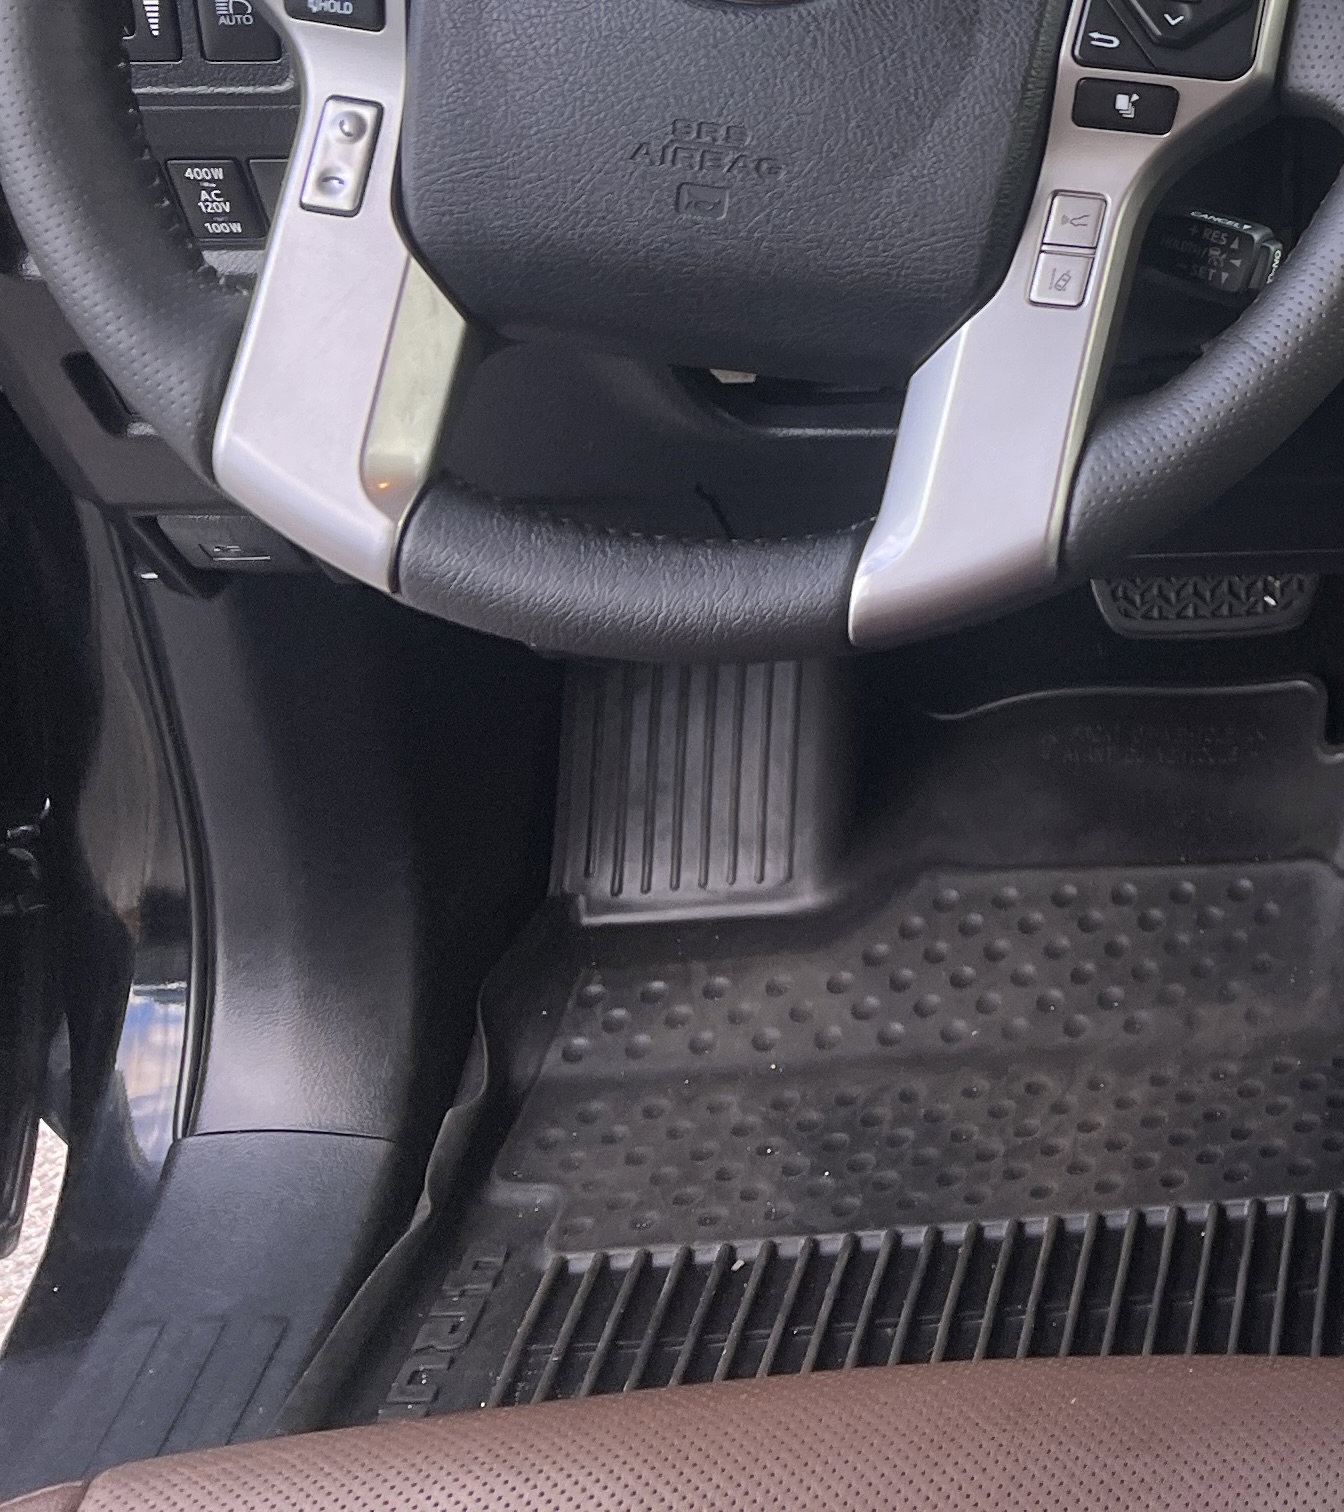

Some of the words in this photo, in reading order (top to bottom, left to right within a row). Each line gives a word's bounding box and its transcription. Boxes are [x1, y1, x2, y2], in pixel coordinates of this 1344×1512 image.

[218, 13, 253, 26] AUTO
[628, 140, 787, 180] AIRBAG
[184, 167, 224, 181] 400W
[200, 189, 224, 202] AC
[198, 201, 230, 214] 120V
[1189, 210, 1241, 229] CANCEL
[204, 221, 242, 234] 100W
